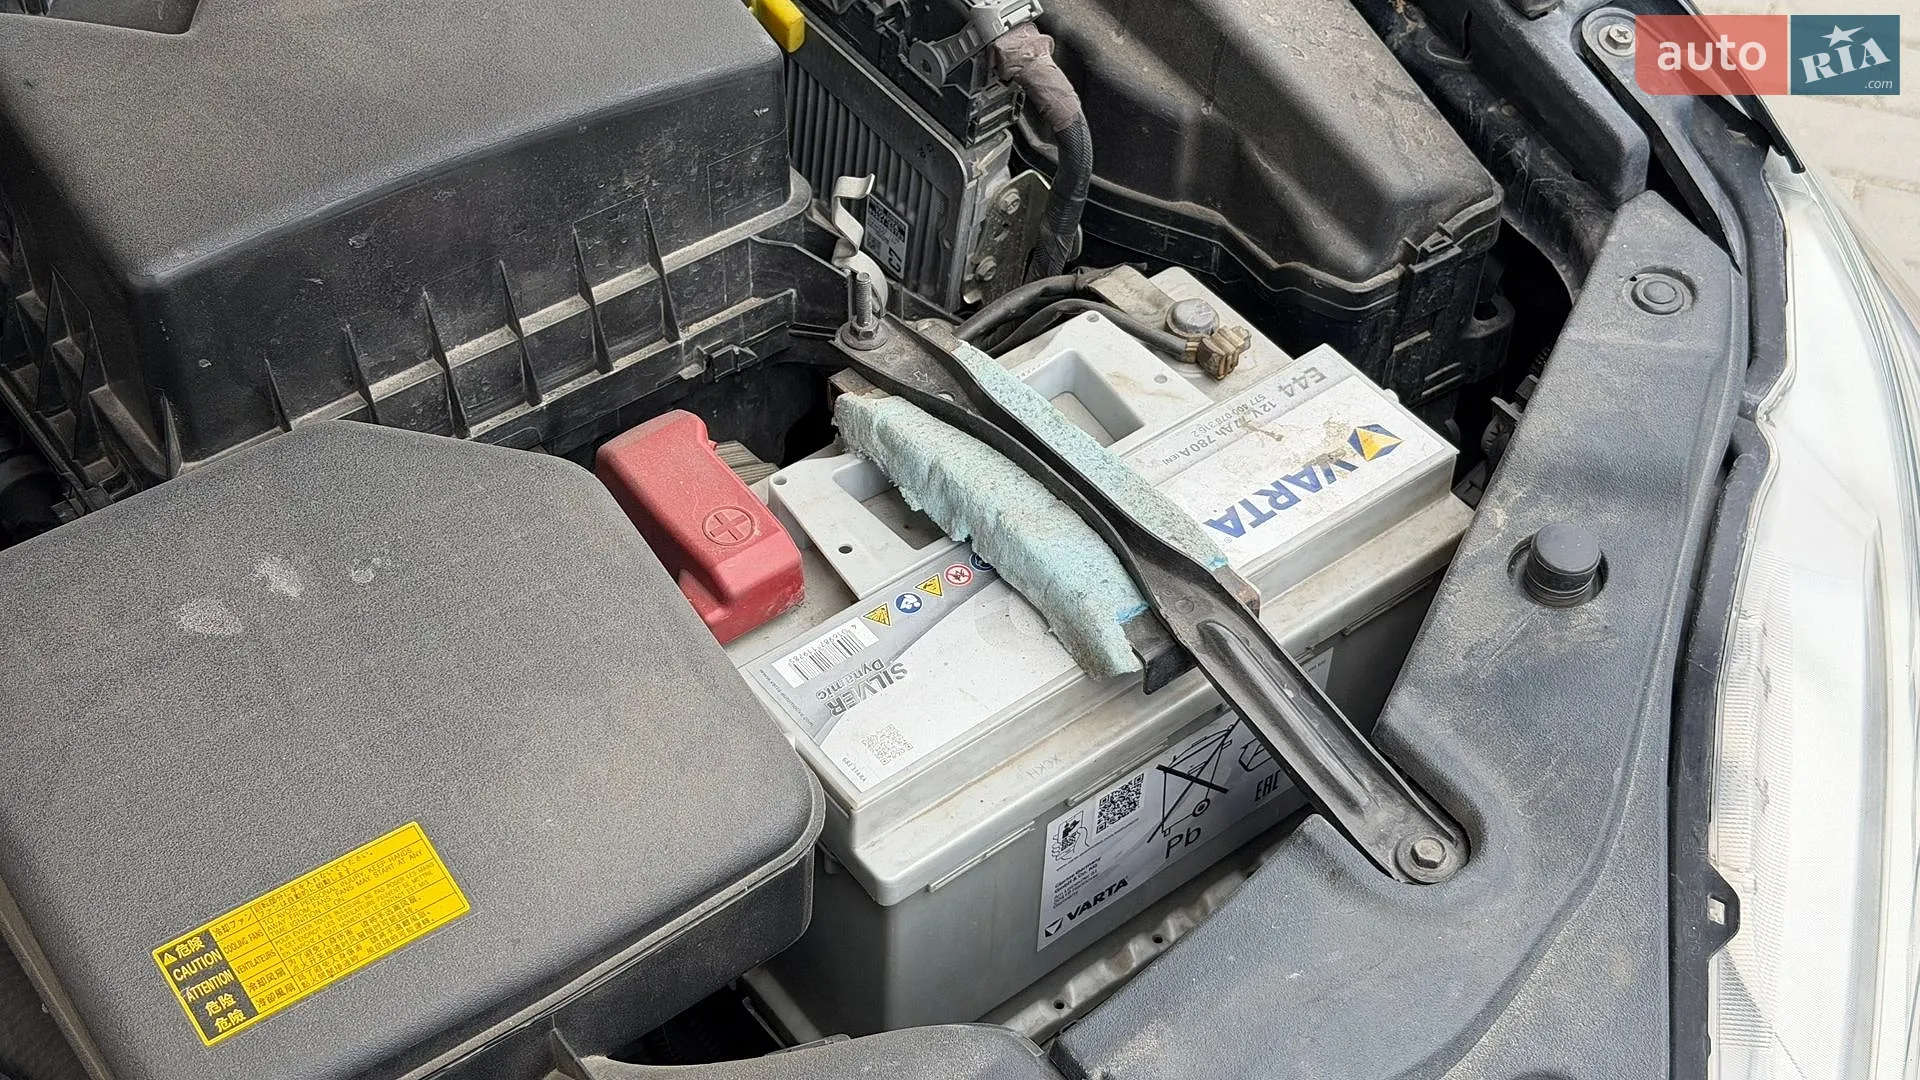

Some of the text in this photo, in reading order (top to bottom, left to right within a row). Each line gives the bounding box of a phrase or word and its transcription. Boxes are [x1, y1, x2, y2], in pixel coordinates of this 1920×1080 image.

[1277, 366, 1327, 399] E44
[1202, 459, 1360, 539] VARTA
[815, 658, 886, 701] Dynamic
[824, 662, 908, 717] SILVER
[1164, 825, 1201, 860] Pb
[263, 917, 273, 925] TO
[276, 905, 298, 919] AVOID
[300, 885, 337, 907] PERSONAL
[367, 860, 387, 873] KEEP
[388, 847, 412, 862] HANDS
[266, 918, 286, 931] AWAY
[289, 907, 310, 919] FROM
[335, 884, 354, 896] FANS
[356, 876, 371, 886] MAY
[373, 864, 395, 877] START
[408, 849, 423, 859] ANY
[1067, 878, 1128, 920] VARTA
[270, 925, 288, 937] TIME
[290, 909, 321, 927] IGNITION
[223, 929, 264, 954] COOLING FANS
[172, 949, 223, 982] CAUTION
[235, 949, 276, 974] VENTILATEURS
[184, 969, 234, 1002] ATTENTION
[203, 991, 237, 1016] 危险
